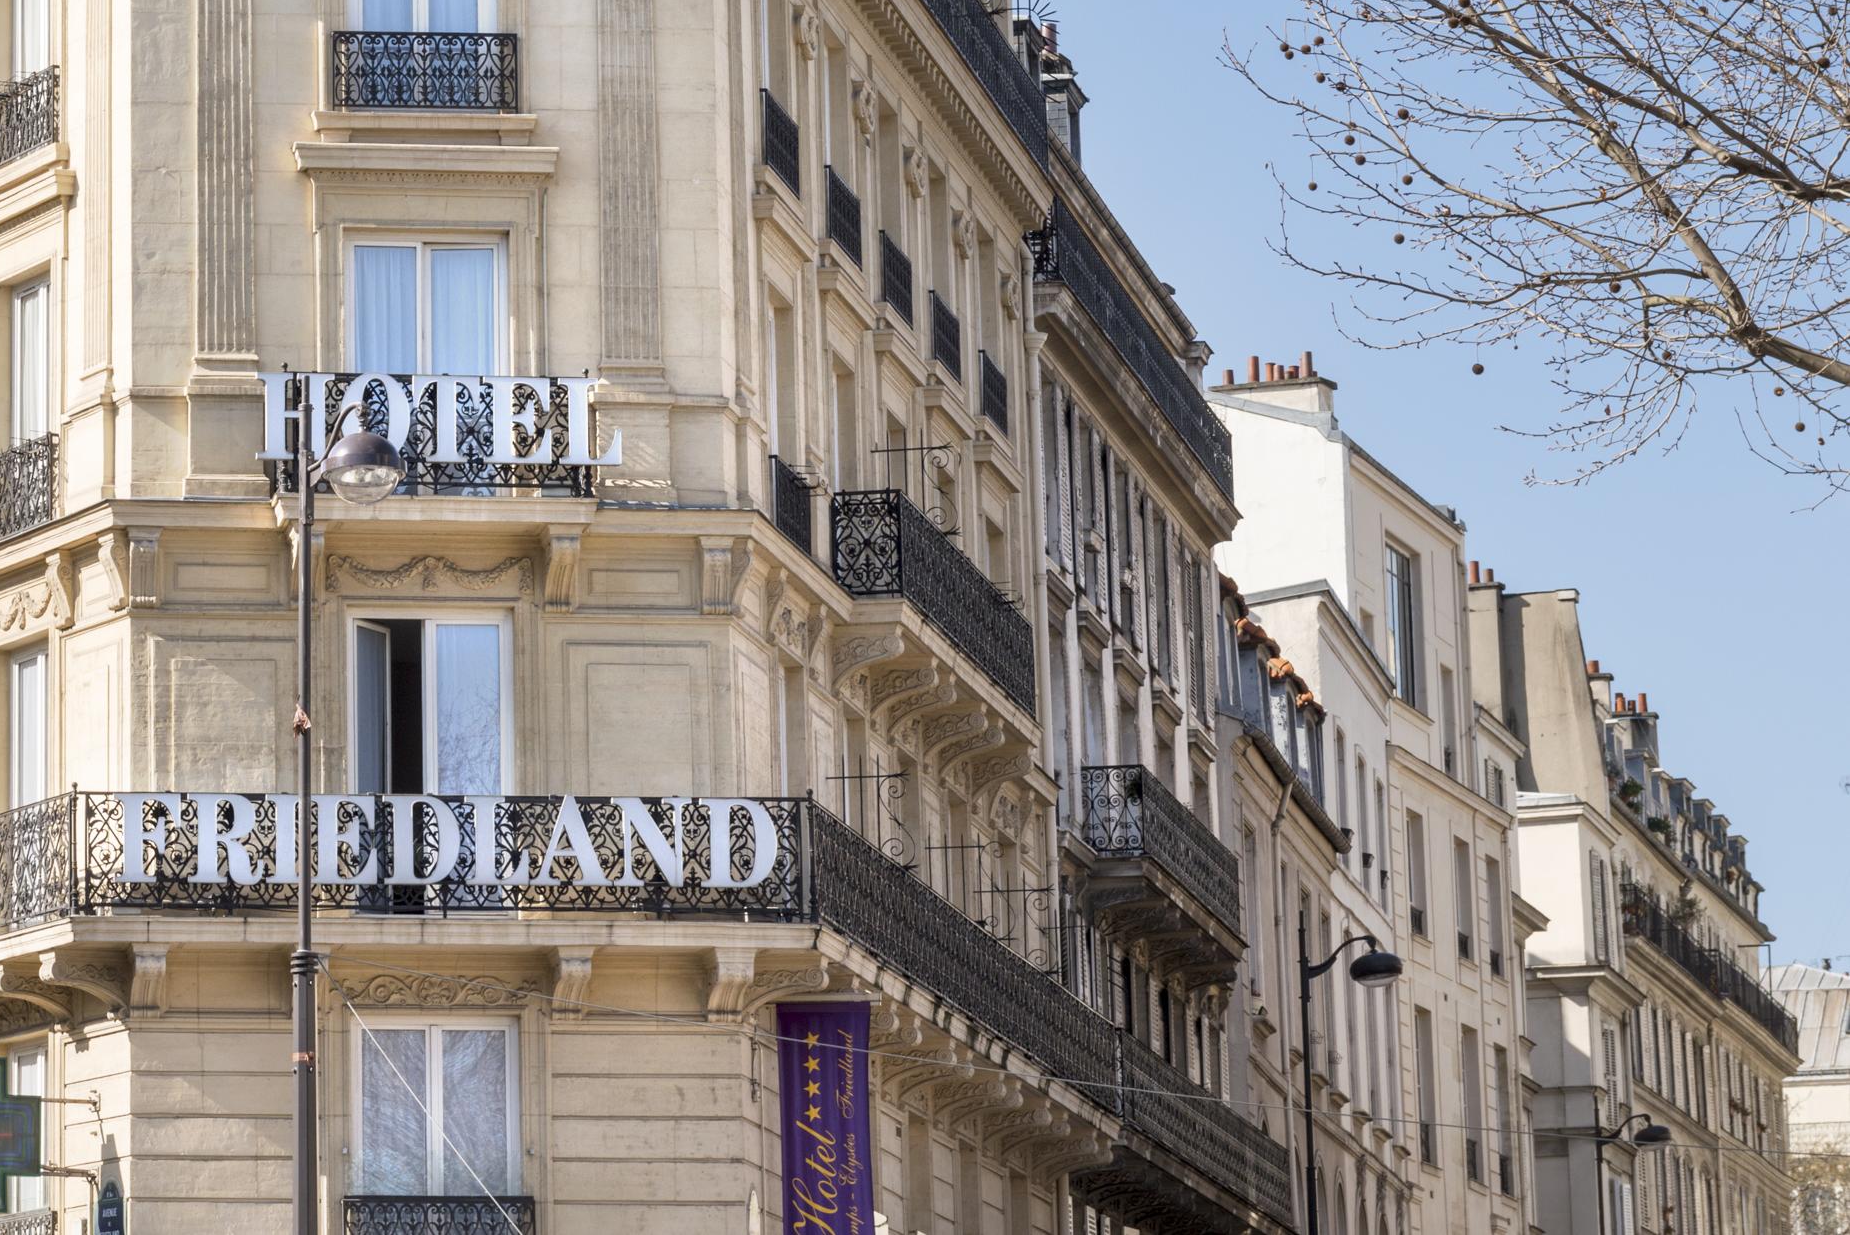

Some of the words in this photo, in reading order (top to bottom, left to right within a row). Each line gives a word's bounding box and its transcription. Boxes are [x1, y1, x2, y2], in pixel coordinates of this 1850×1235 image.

[255, 371, 623, 466] HOTEL
[113, 793, 778, 889] FRIEDLAND
[836, 1029, 854, 1119] Friedland
[792, 1120, 838, 1235] Hotel
